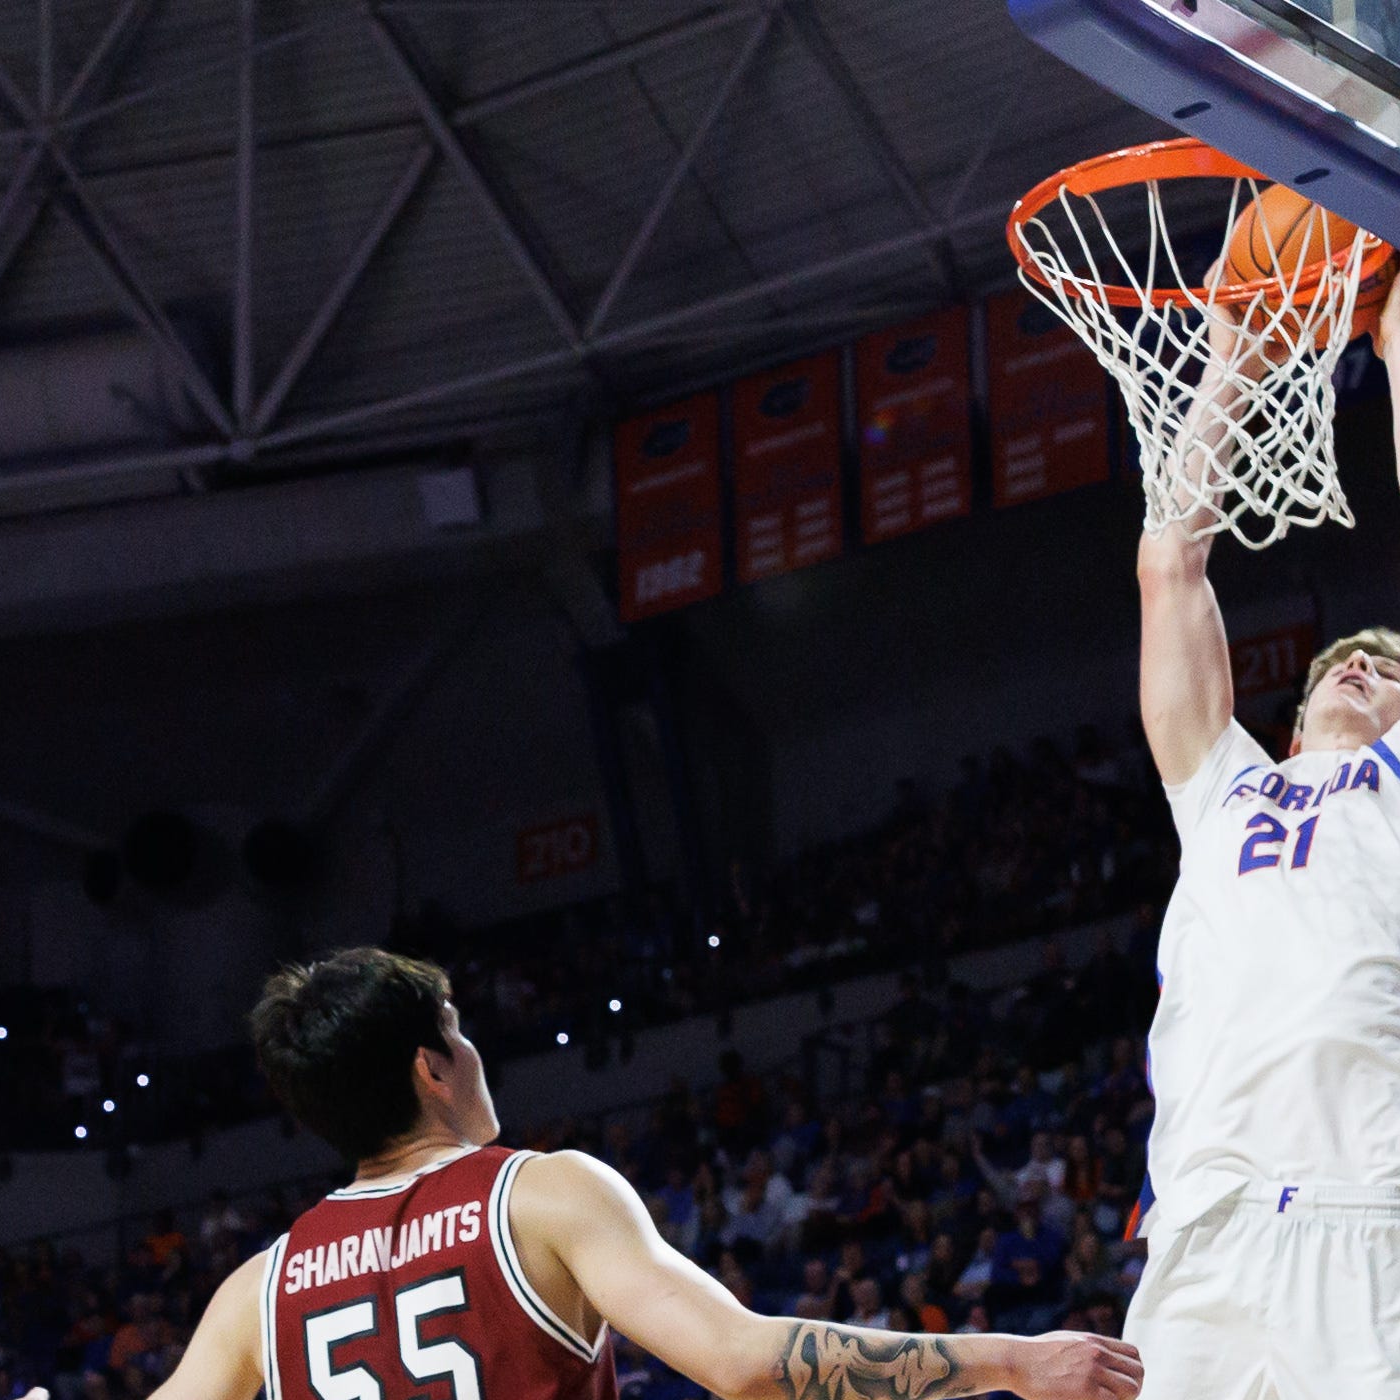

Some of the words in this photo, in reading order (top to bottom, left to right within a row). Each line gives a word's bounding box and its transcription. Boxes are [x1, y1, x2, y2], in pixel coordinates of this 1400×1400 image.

[1237, 638, 1297, 688] 211
[1222, 759, 1380, 811] FORIDA
[1238, 811, 1321, 877] 21
[1276, 1187, 1298, 1213] F
[284, 1200, 483, 1295] SHARAVJAMTS
